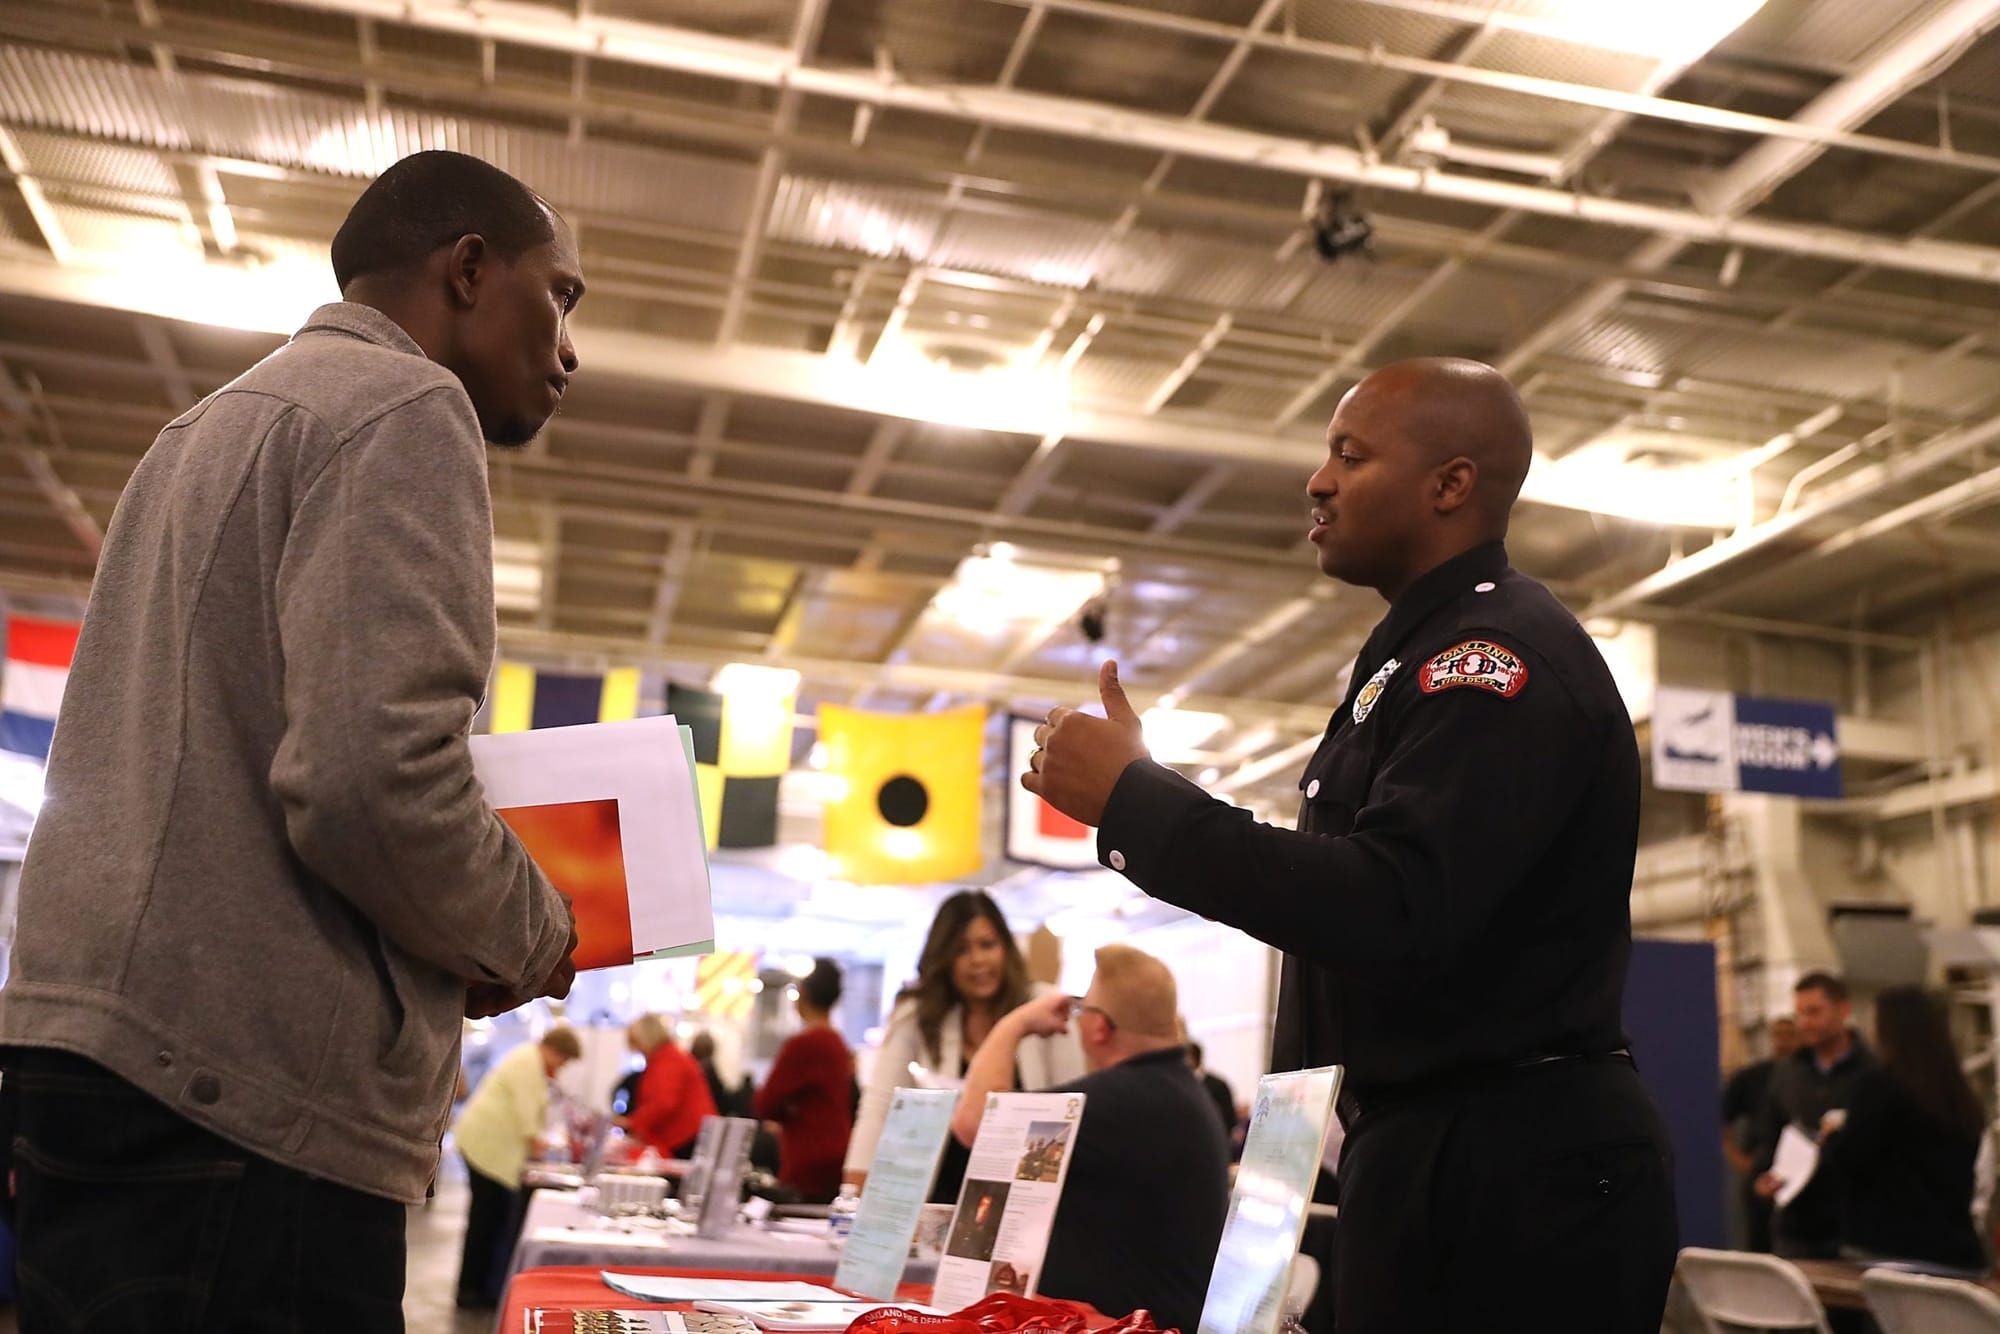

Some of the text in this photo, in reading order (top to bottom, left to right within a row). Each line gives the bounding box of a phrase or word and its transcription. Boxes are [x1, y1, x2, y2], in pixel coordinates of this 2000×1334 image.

[1441, 642, 1512, 662] OAKLAND
[1441, 677, 1465, 686] FIRE
[864, 1308, 903, 1322] OAKLAND
[903, 1312, 919, 1324] FIRE
